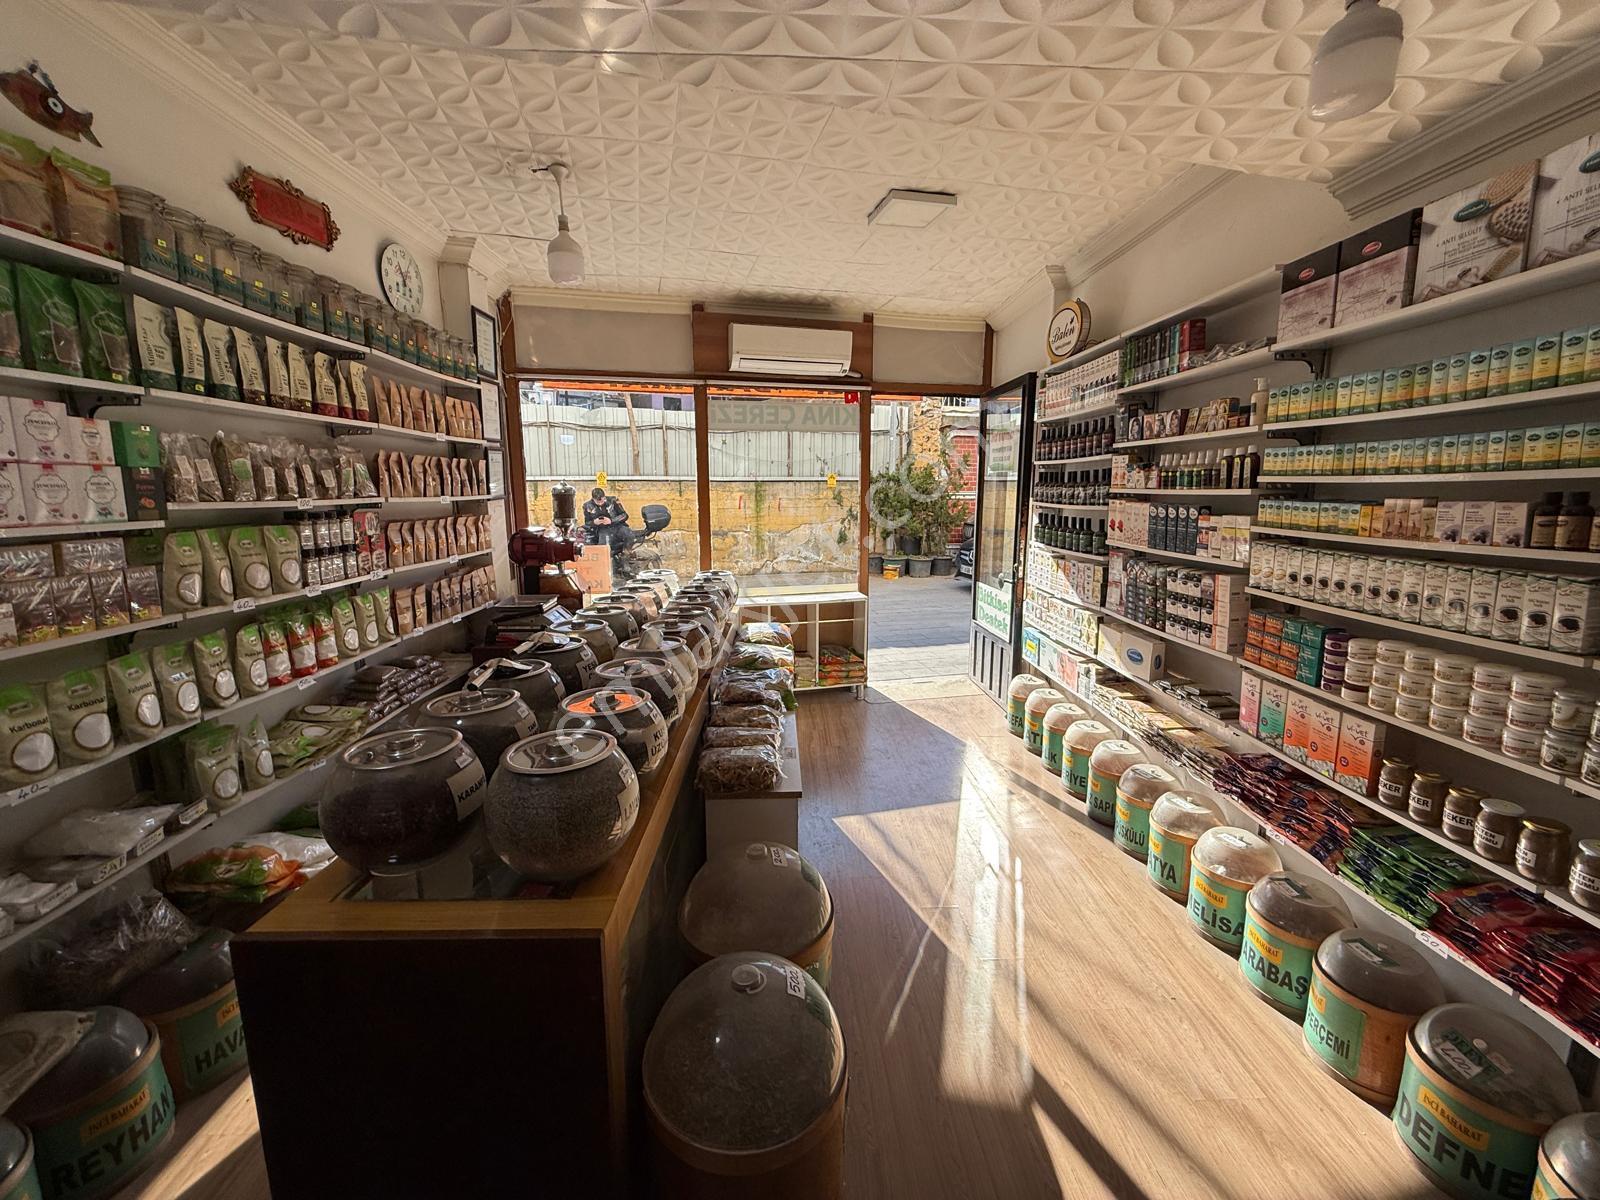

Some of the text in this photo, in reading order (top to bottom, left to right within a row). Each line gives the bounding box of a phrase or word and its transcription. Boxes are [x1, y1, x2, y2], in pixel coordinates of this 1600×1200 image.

[49, 1085, 173, 1198] REYHAN
[1399, 1091, 1532, 1200] DEFNE
[1438, 1109, 1483, 1144] BAHARAT
